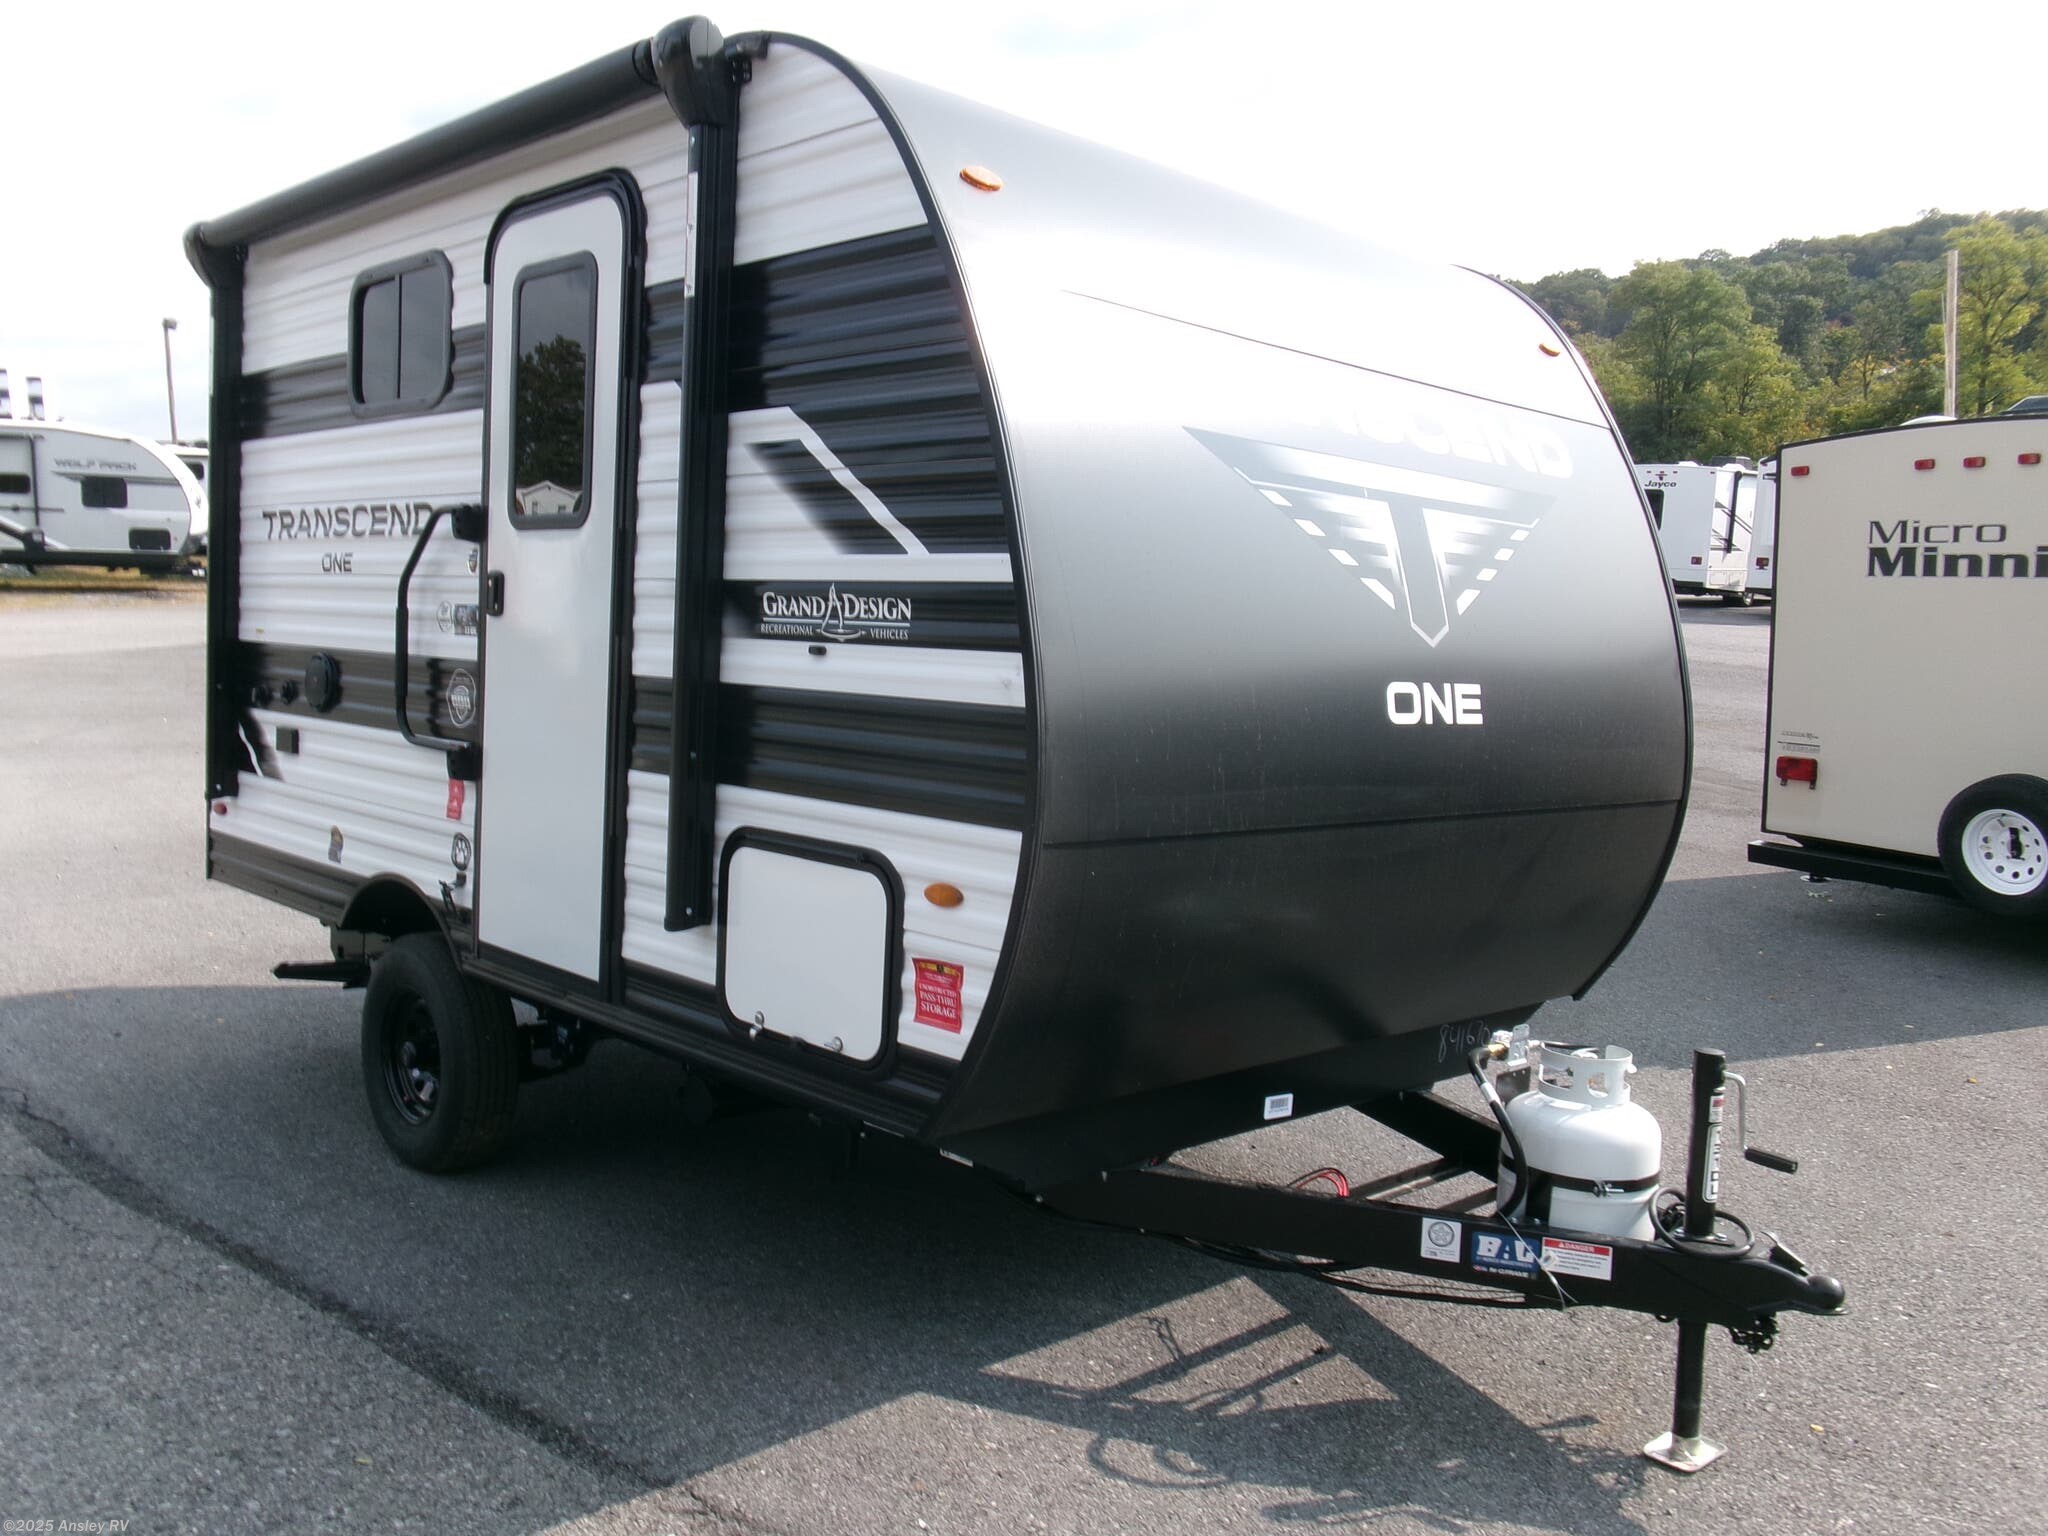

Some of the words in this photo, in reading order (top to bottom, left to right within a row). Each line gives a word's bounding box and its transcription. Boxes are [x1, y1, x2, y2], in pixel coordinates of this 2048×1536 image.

[1644, 480, 1677, 489] Jayco
[262, 502, 436, 540] TRANSCEND
[1868, 519, 2008, 545] Micro
[321, 552, 354, 574] ONE
[1867, 545, 2048, 578] Minni
[762, 591, 826, 618] GRAND
[841, 592, 912, 621] DESIGN
[760, 623, 814, 636] RECREATIONAL
[869, 628, 909, 640] VEHICLES
[1385, 680, 1484, 725] ONE
[919, 990, 957, 1007] PASS-THRU
[920, 1001, 957, 1019] STORAGE
[1564, 1242, 1596, 1253] DANGER
